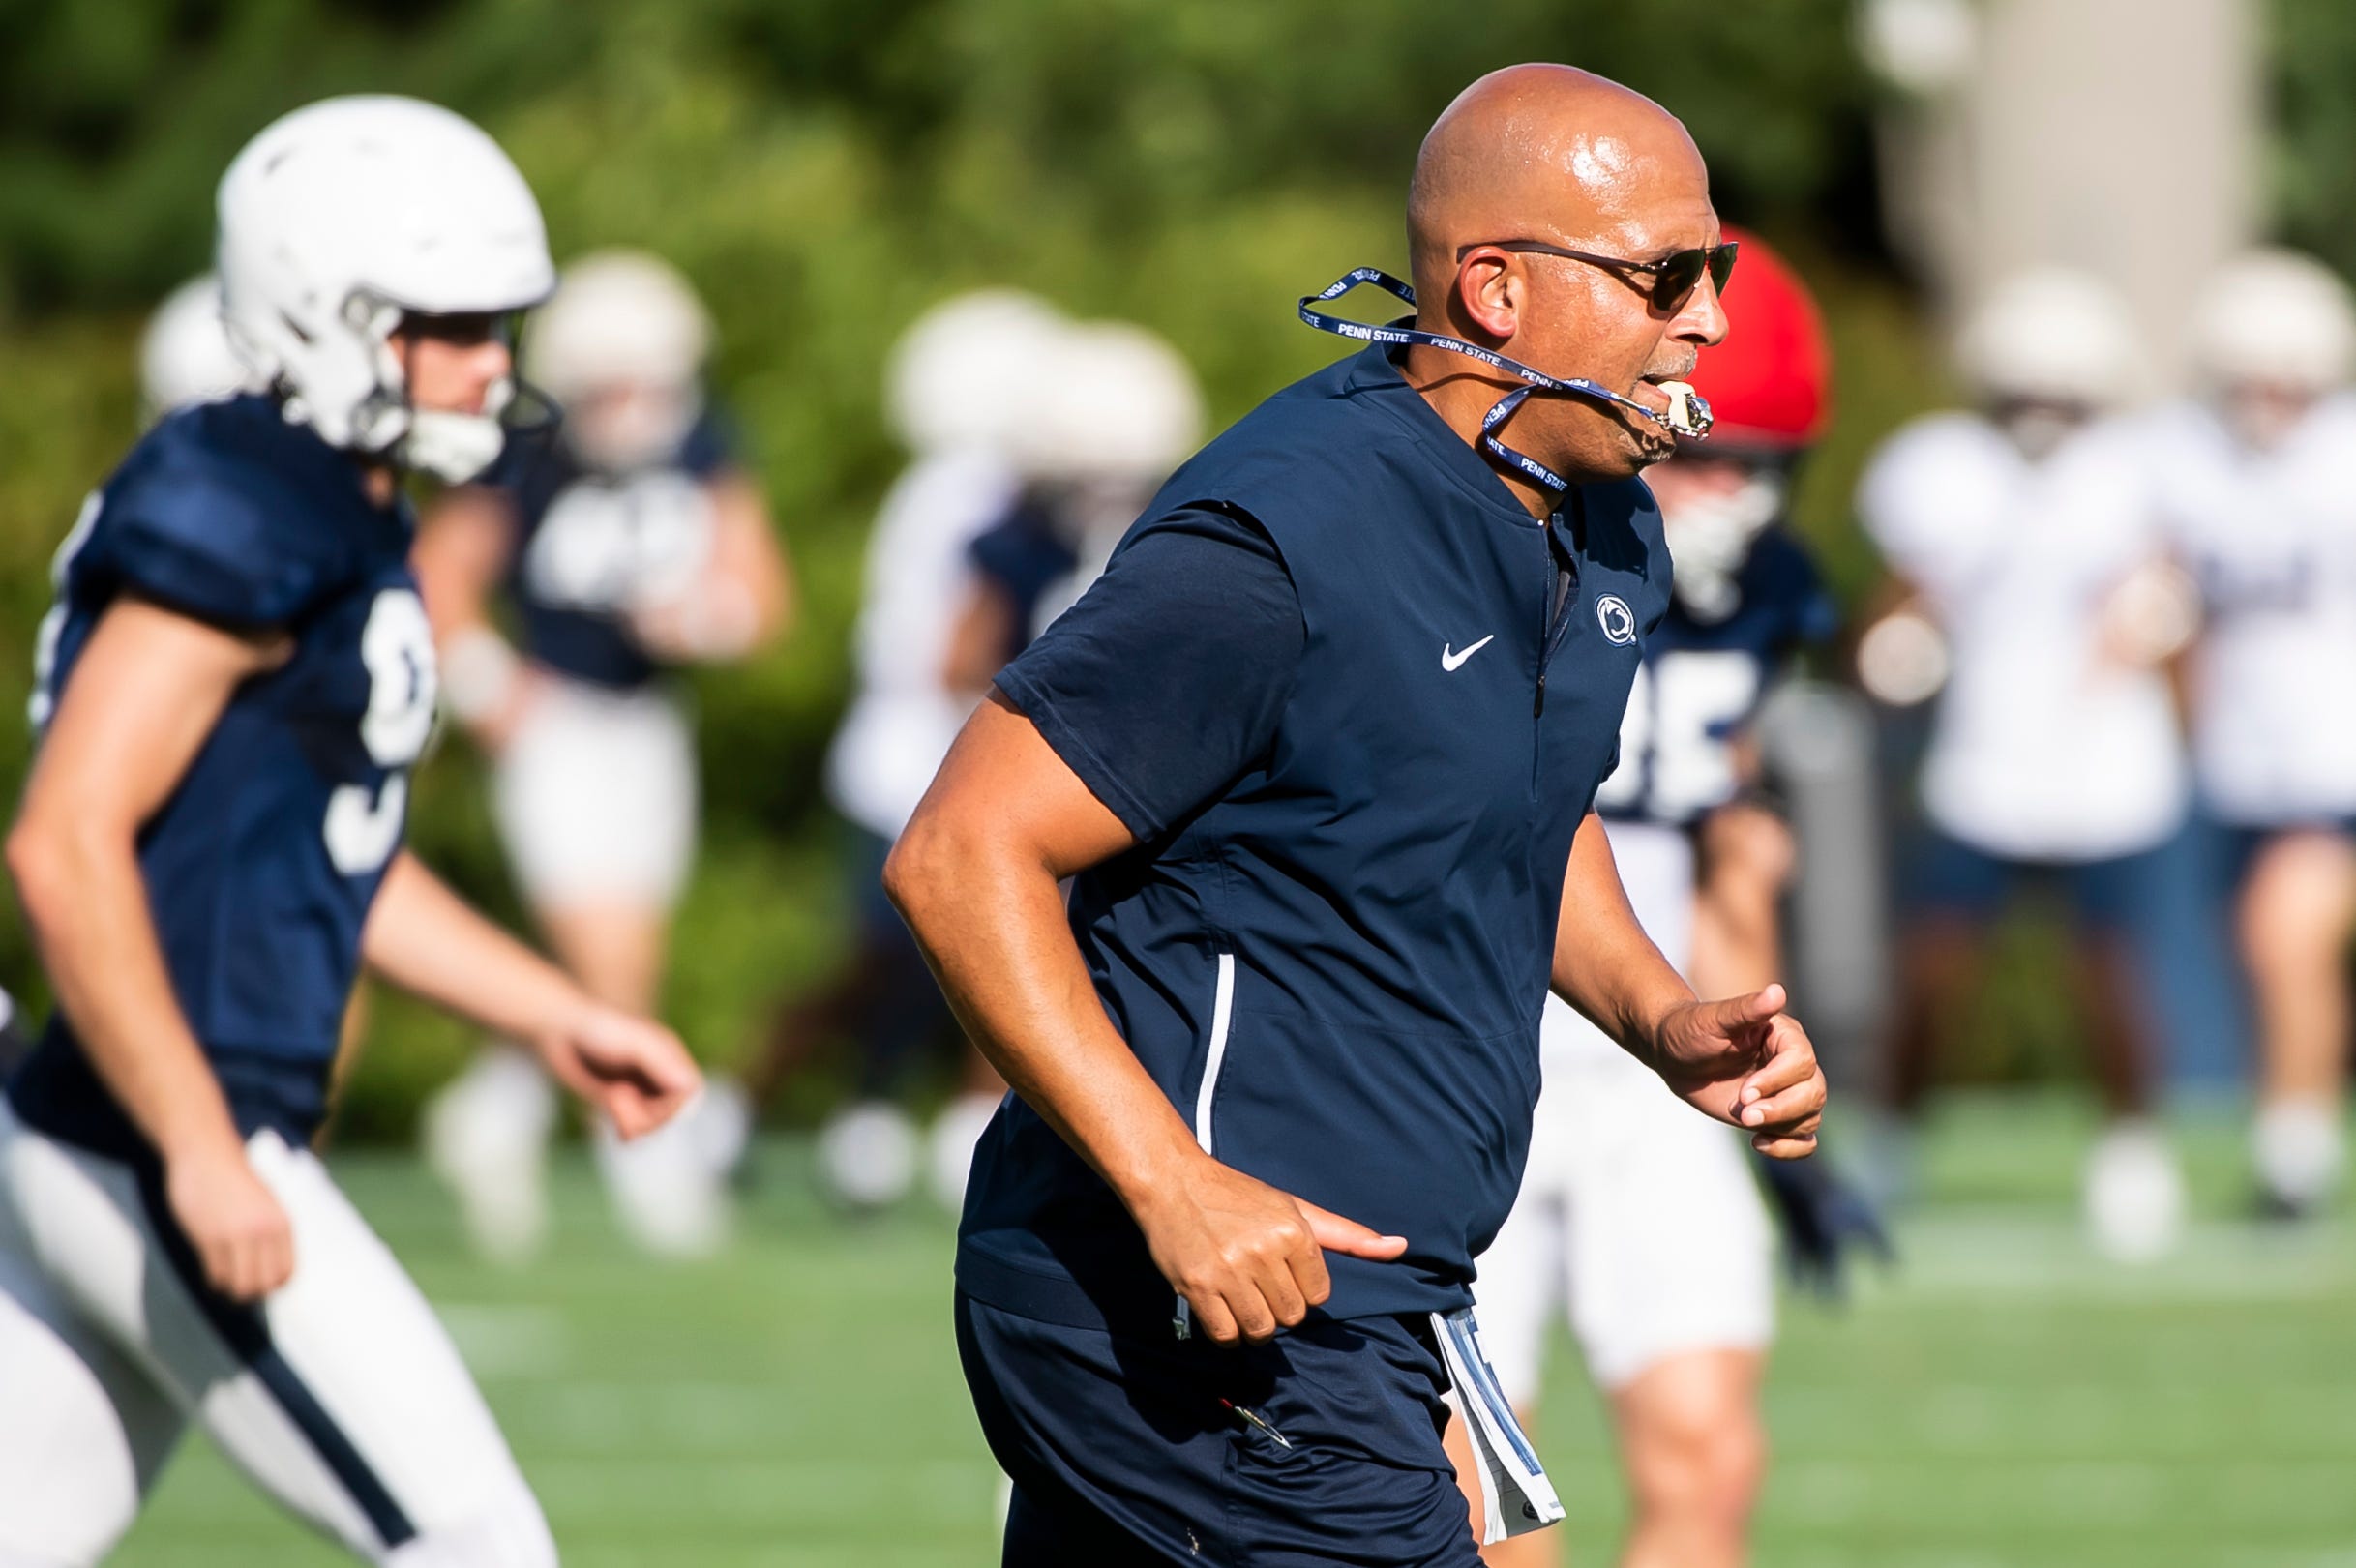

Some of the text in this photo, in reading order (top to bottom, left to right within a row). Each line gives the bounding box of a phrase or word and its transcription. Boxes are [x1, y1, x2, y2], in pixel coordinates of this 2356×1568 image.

[1338, 324, 1409, 342] PENN STATE
[1430, 337, 1501, 367] PENN STATE
[1520, 369, 1553, 388] PENN
[1521, 458, 1546, 480] PENN
